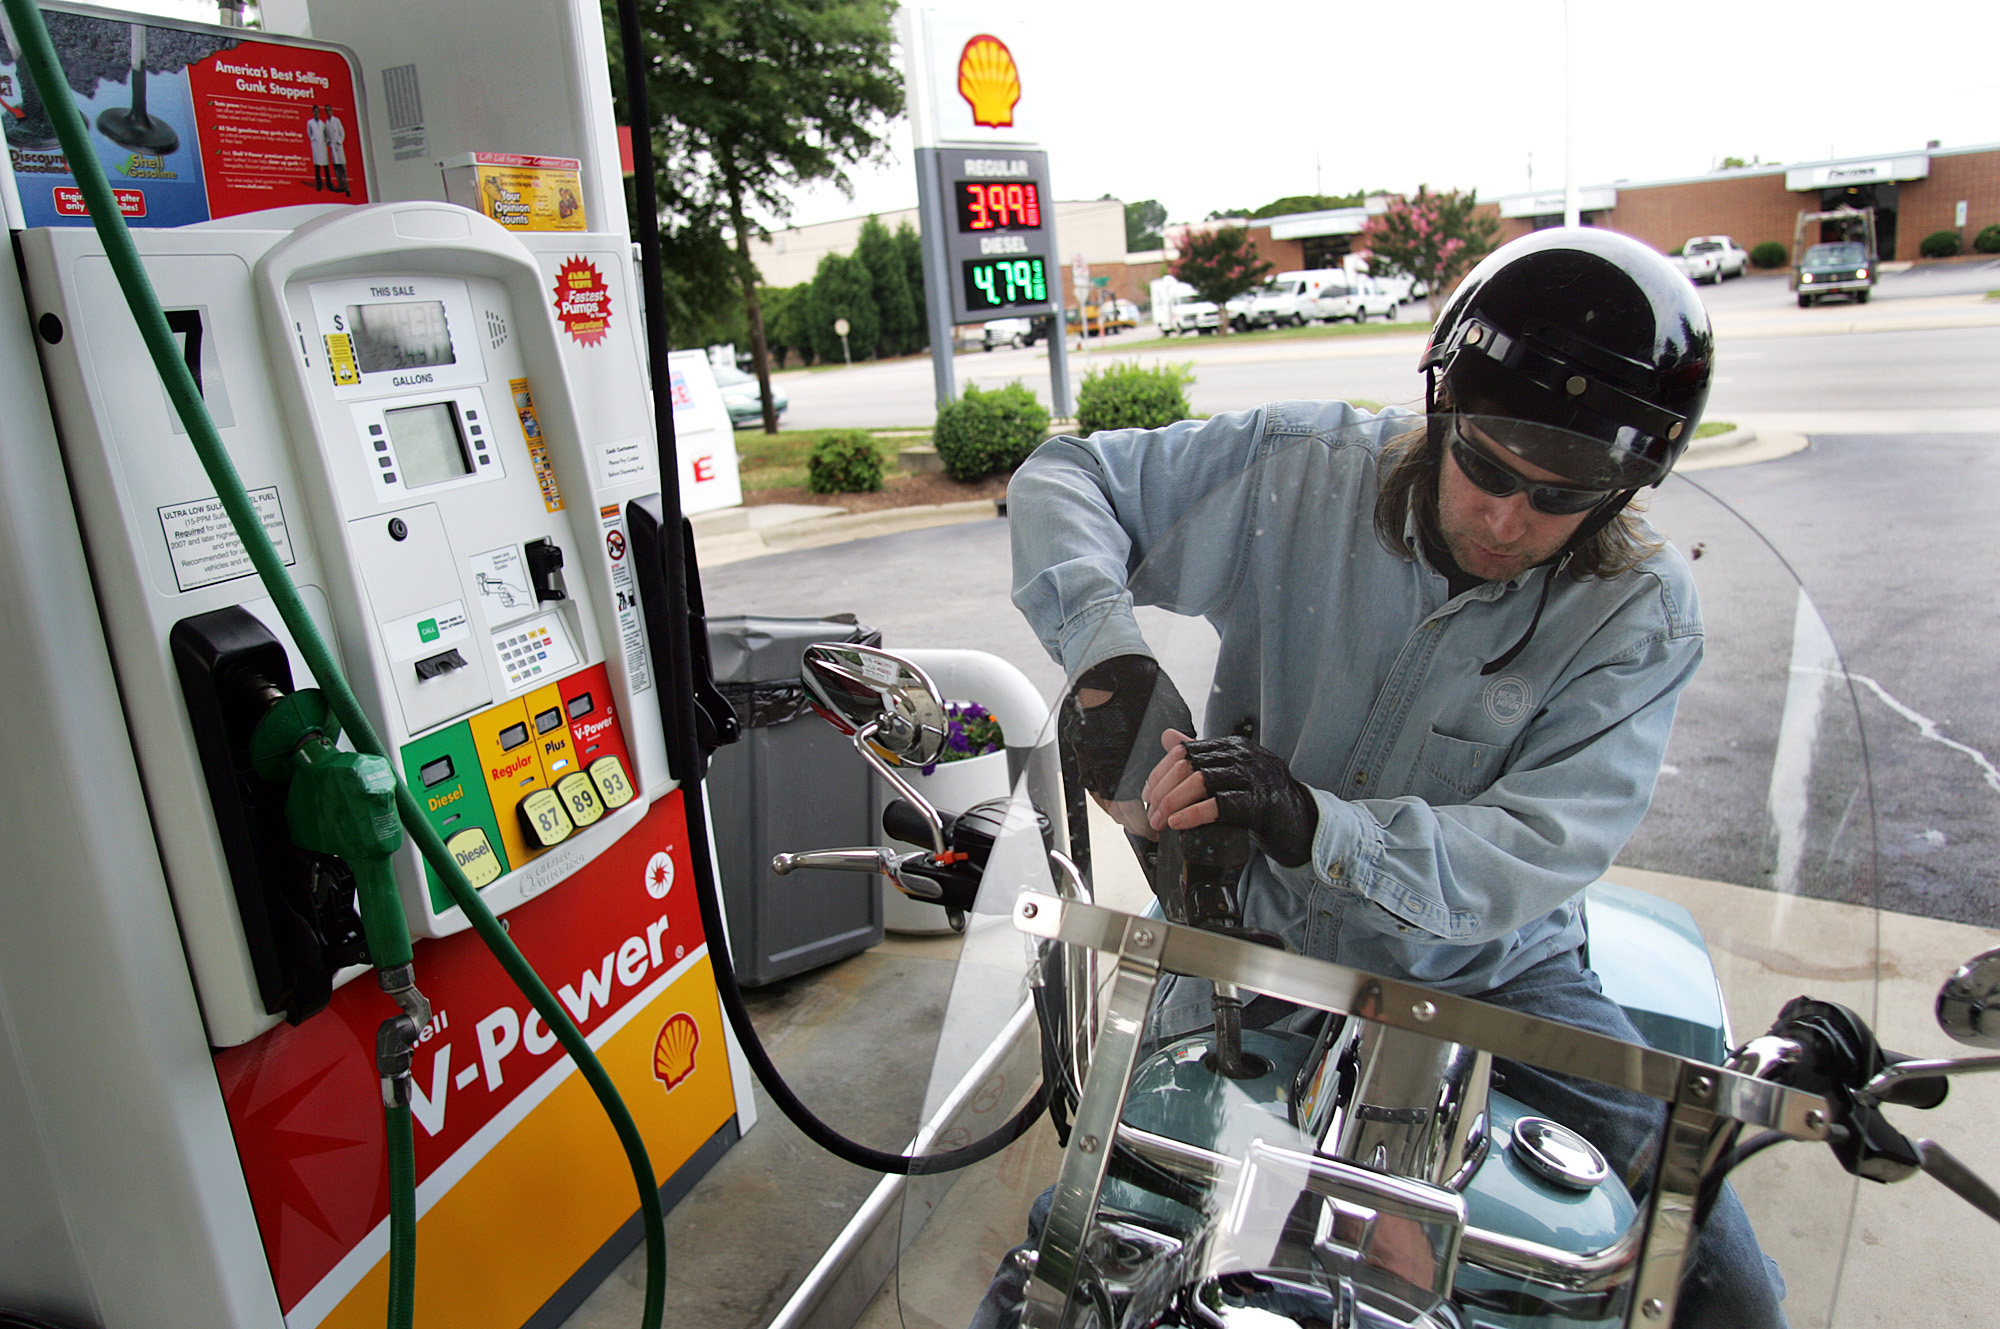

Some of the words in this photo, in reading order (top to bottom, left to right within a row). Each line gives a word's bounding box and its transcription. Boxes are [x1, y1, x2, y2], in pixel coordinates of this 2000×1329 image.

[215, 60, 268, 78] America's
[270, 67, 293, 81] Best
[296, 70, 329, 89] Selling
[236, 78, 267, 93] Gunk
[269, 82, 314, 100] Stopper!
[13, 161, 69, 174] Gasoline
[131, 153, 164, 169] Shell
[964, 158, 1029, 177] REGULAR
[128, 167, 177, 179] Gasoline
[121, 193, 140, 203] after
[500, 189, 521, 202] Your
[65, 202, 84, 212] only
[494, 200, 531, 214] Opinion
[500, 215, 529, 225] counts
[980, 235, 1029, 255] DIESEL
[370, 287, 391, 297] THIS
[392, 286, 415, 296] SALE
[568, 290, 605, 303] Fastest
[561, 301, 599, 316] Pumps
[333, 314, 344, 331] $
[392, 373, 434, 387] GALLONS
[164, 510, 188, 520] ULTRA
[188, 506, 205, 515] LOW
[206, 502, 223, 511] SULF
[259, 493, 276, 501] FUEL
[175, 526, 205, 539] Required
[171, 540, 186, 549] 2007
[181, 551, 229, 567] Recommended
[421, 626, 436, 636] CALL
[574, 716, 613, 741] V-Power
[544, 739, 566, 755] Plus
[491, 755, 532, 781] Regular
[427, 784, 464, 812] Diesel
[538, 806, 559, 832] 87
[572, 790, 593, 813] 89
[603, 773, 624, 795] 93
[455, 840, 490, 867] Diesel
[410, 914, 669, 1137] V-Power
[413, 1010, 448, 1048] ell
